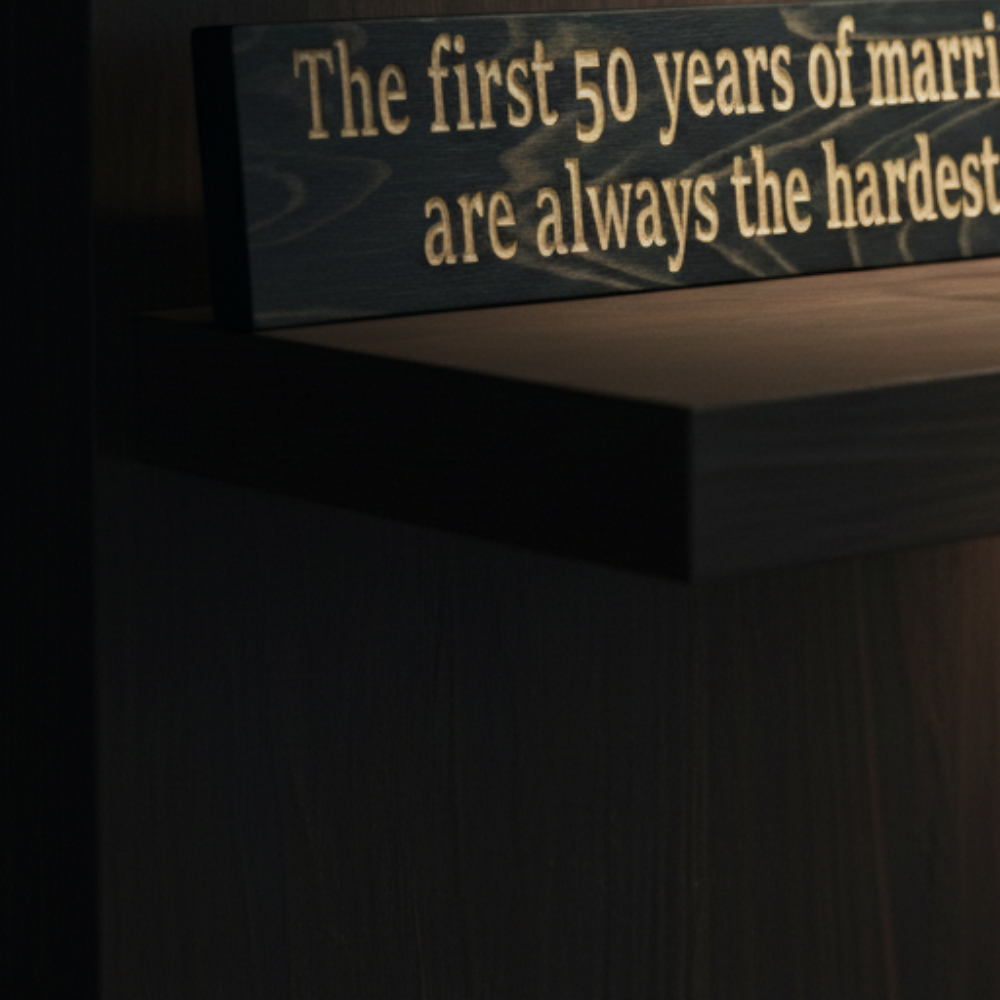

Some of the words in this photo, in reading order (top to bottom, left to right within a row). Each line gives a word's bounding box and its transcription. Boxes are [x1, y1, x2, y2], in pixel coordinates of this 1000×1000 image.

[293, 38, 410, 140] The
[427, 33, 559, 133] first
[574, 47, 638, 143] 50
[653, 43, 795, 146] years
[808, 15, 856, 109] of
[424, 190, 518, 266] are
[536, 157, 720, 273] always
[730, 144, 812, 238] the
